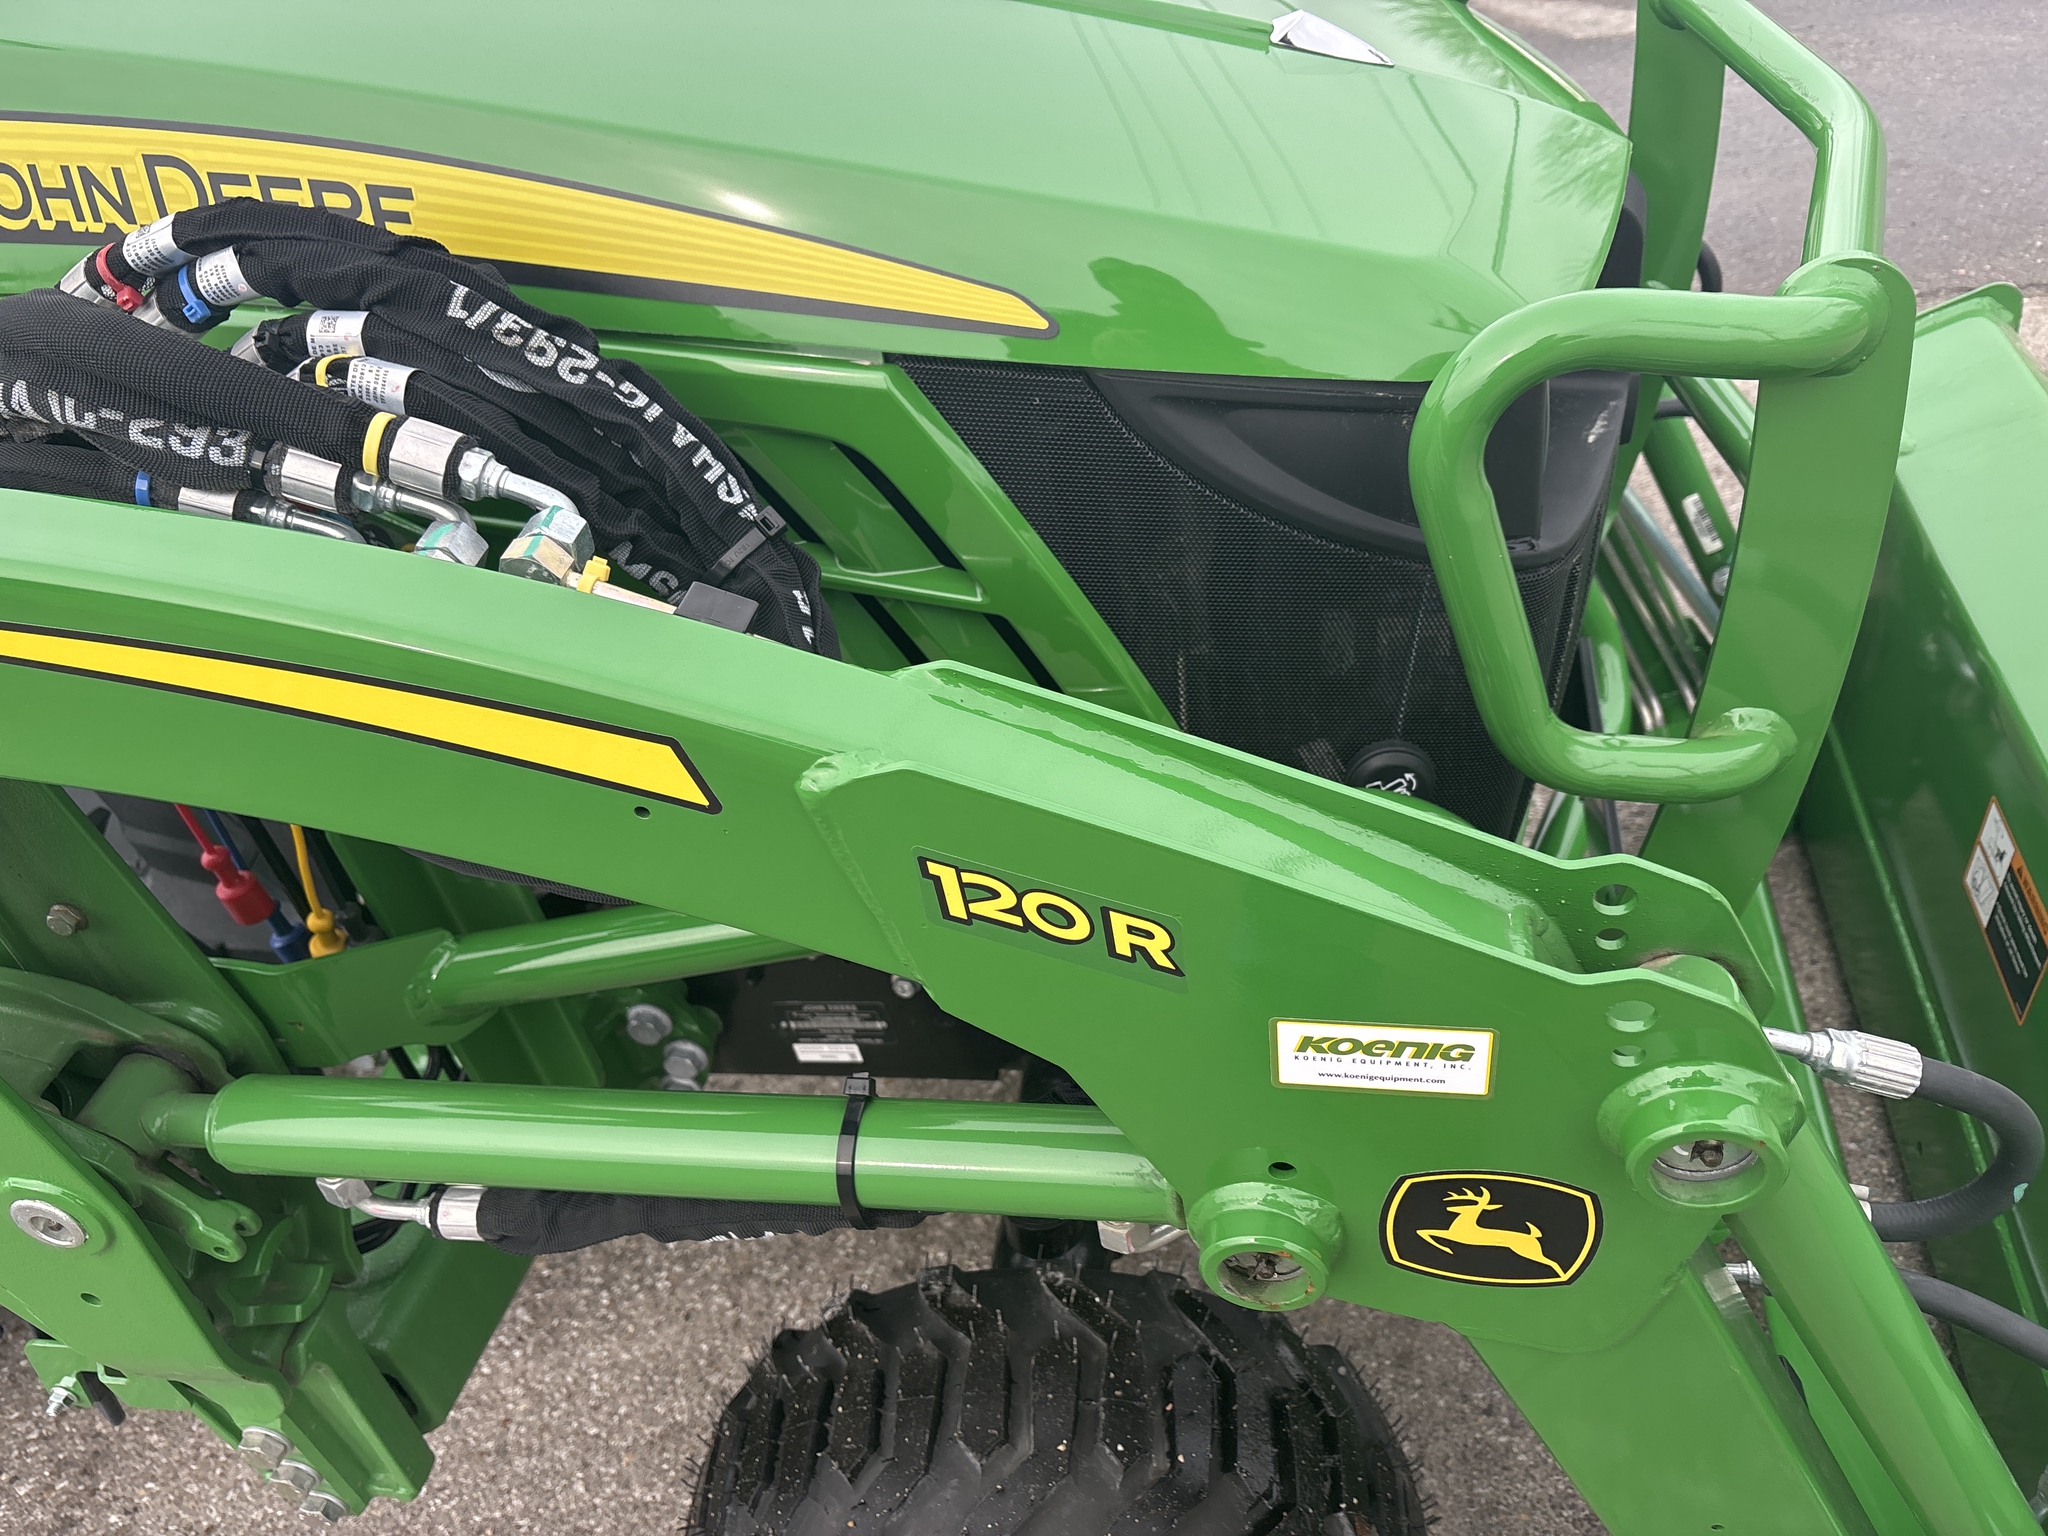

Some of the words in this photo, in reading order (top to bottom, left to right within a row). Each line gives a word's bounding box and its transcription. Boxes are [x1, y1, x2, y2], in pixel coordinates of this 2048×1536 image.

[917, 856, 1095, 945] 120
[1100, 905, 1186, 977] R
[1294, 1054, 1343, 1063] KOENIG
[1352, 1057, 1434, 1070] EQUIPMENT,
[1443, 1063, 1472, 1071] INC.
[1317, 1070, 1446, 1085] www.koenigequipment.com
